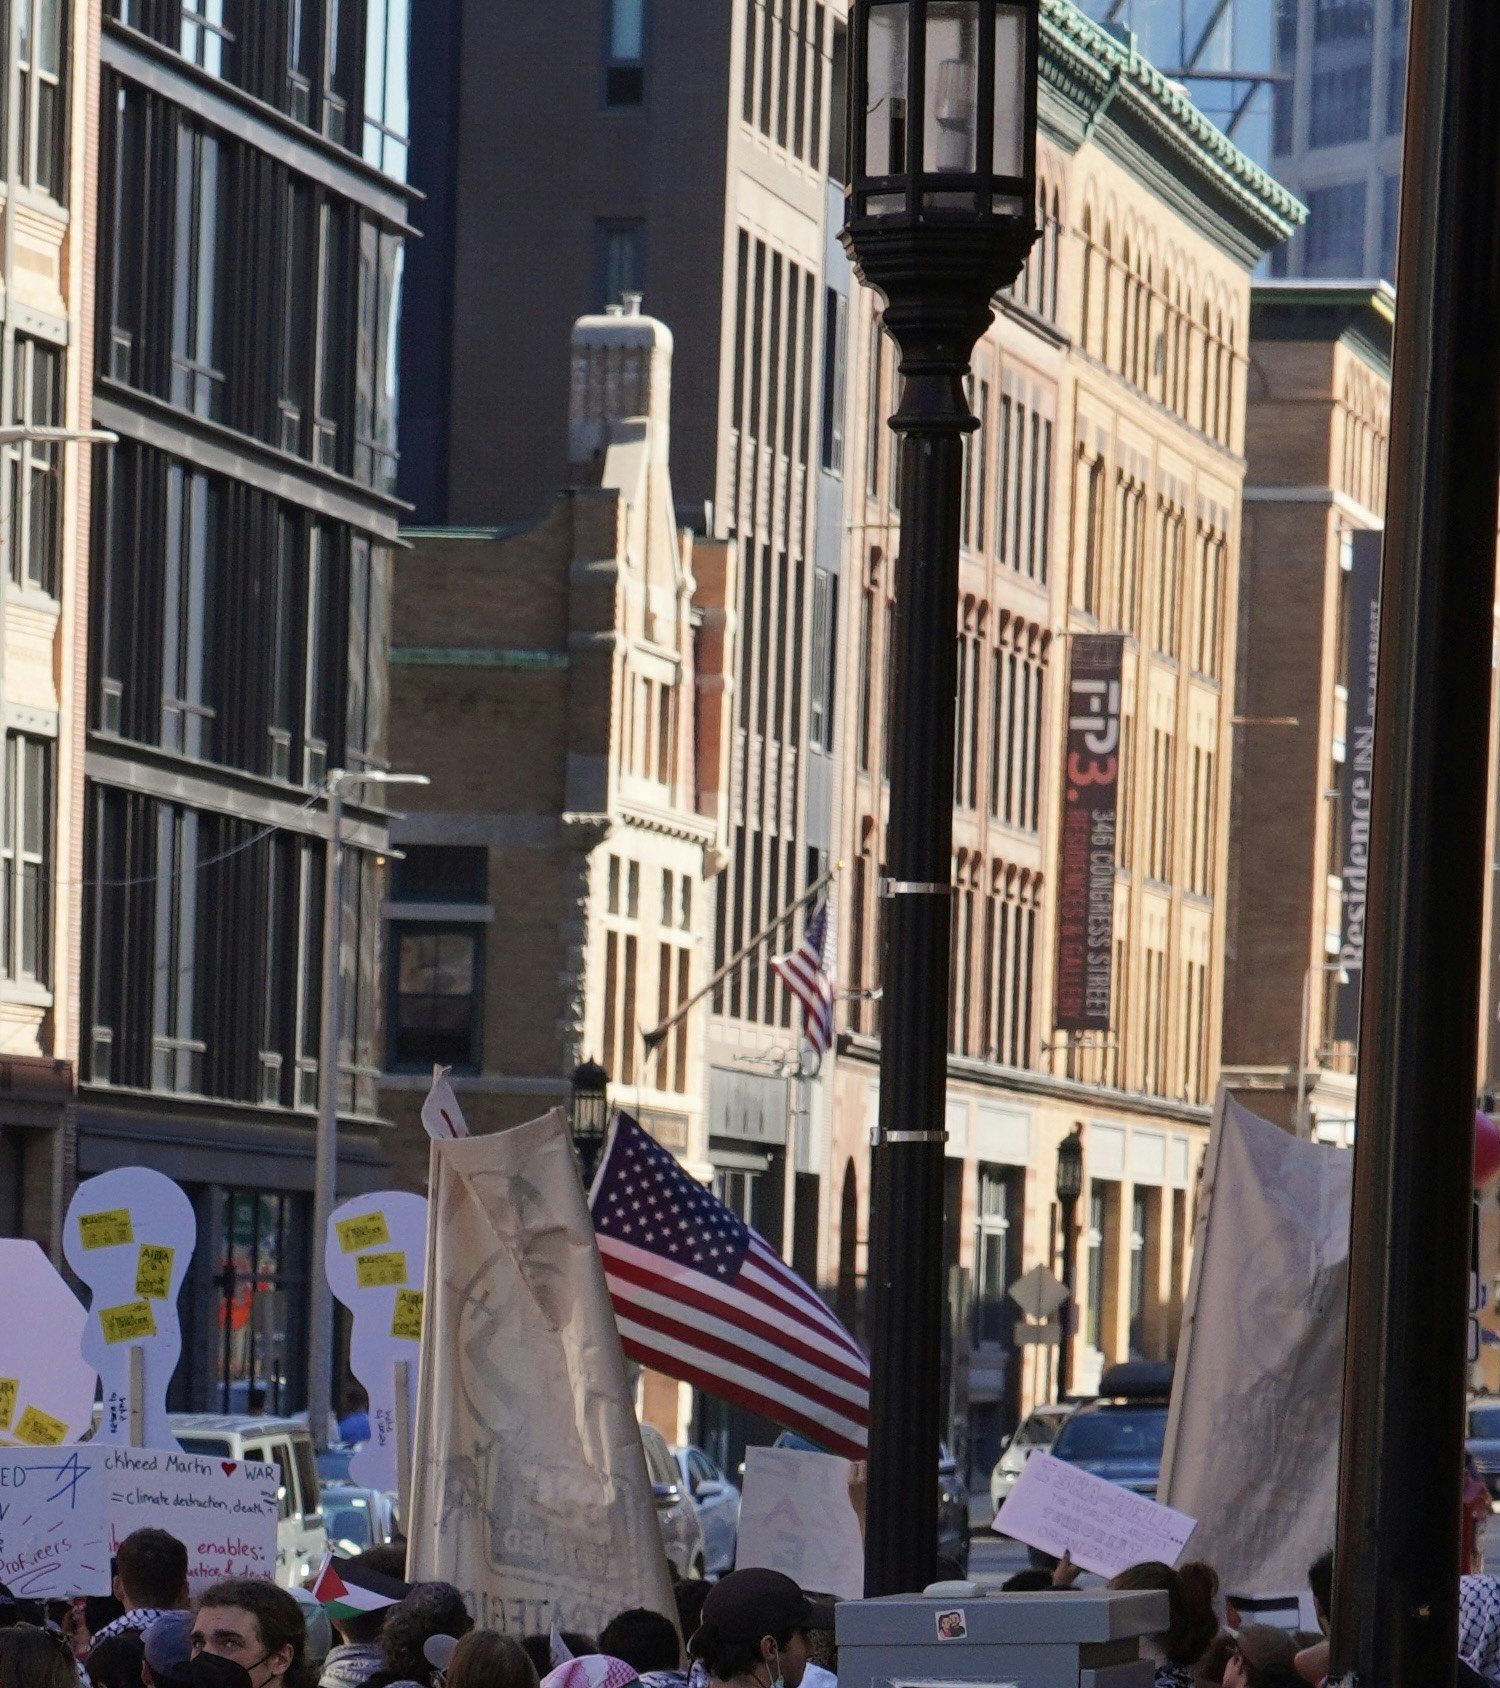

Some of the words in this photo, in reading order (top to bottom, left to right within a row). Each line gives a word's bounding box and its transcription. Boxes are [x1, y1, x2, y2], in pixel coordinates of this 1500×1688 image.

[1091, 809, 1115, 846] 346
[1088, 850, 1113, 948] CONGRESS
[1340, 777, 1372, 970] Residence
[1086, 952, 1111, 1018] STREET
[104, 1450, 157, 1470] ckheed
[166, 1453, 212, 1476] Martin
[244, 1464, 275, 1482] WAR
[197, 1537, 265, 1561] enables:
